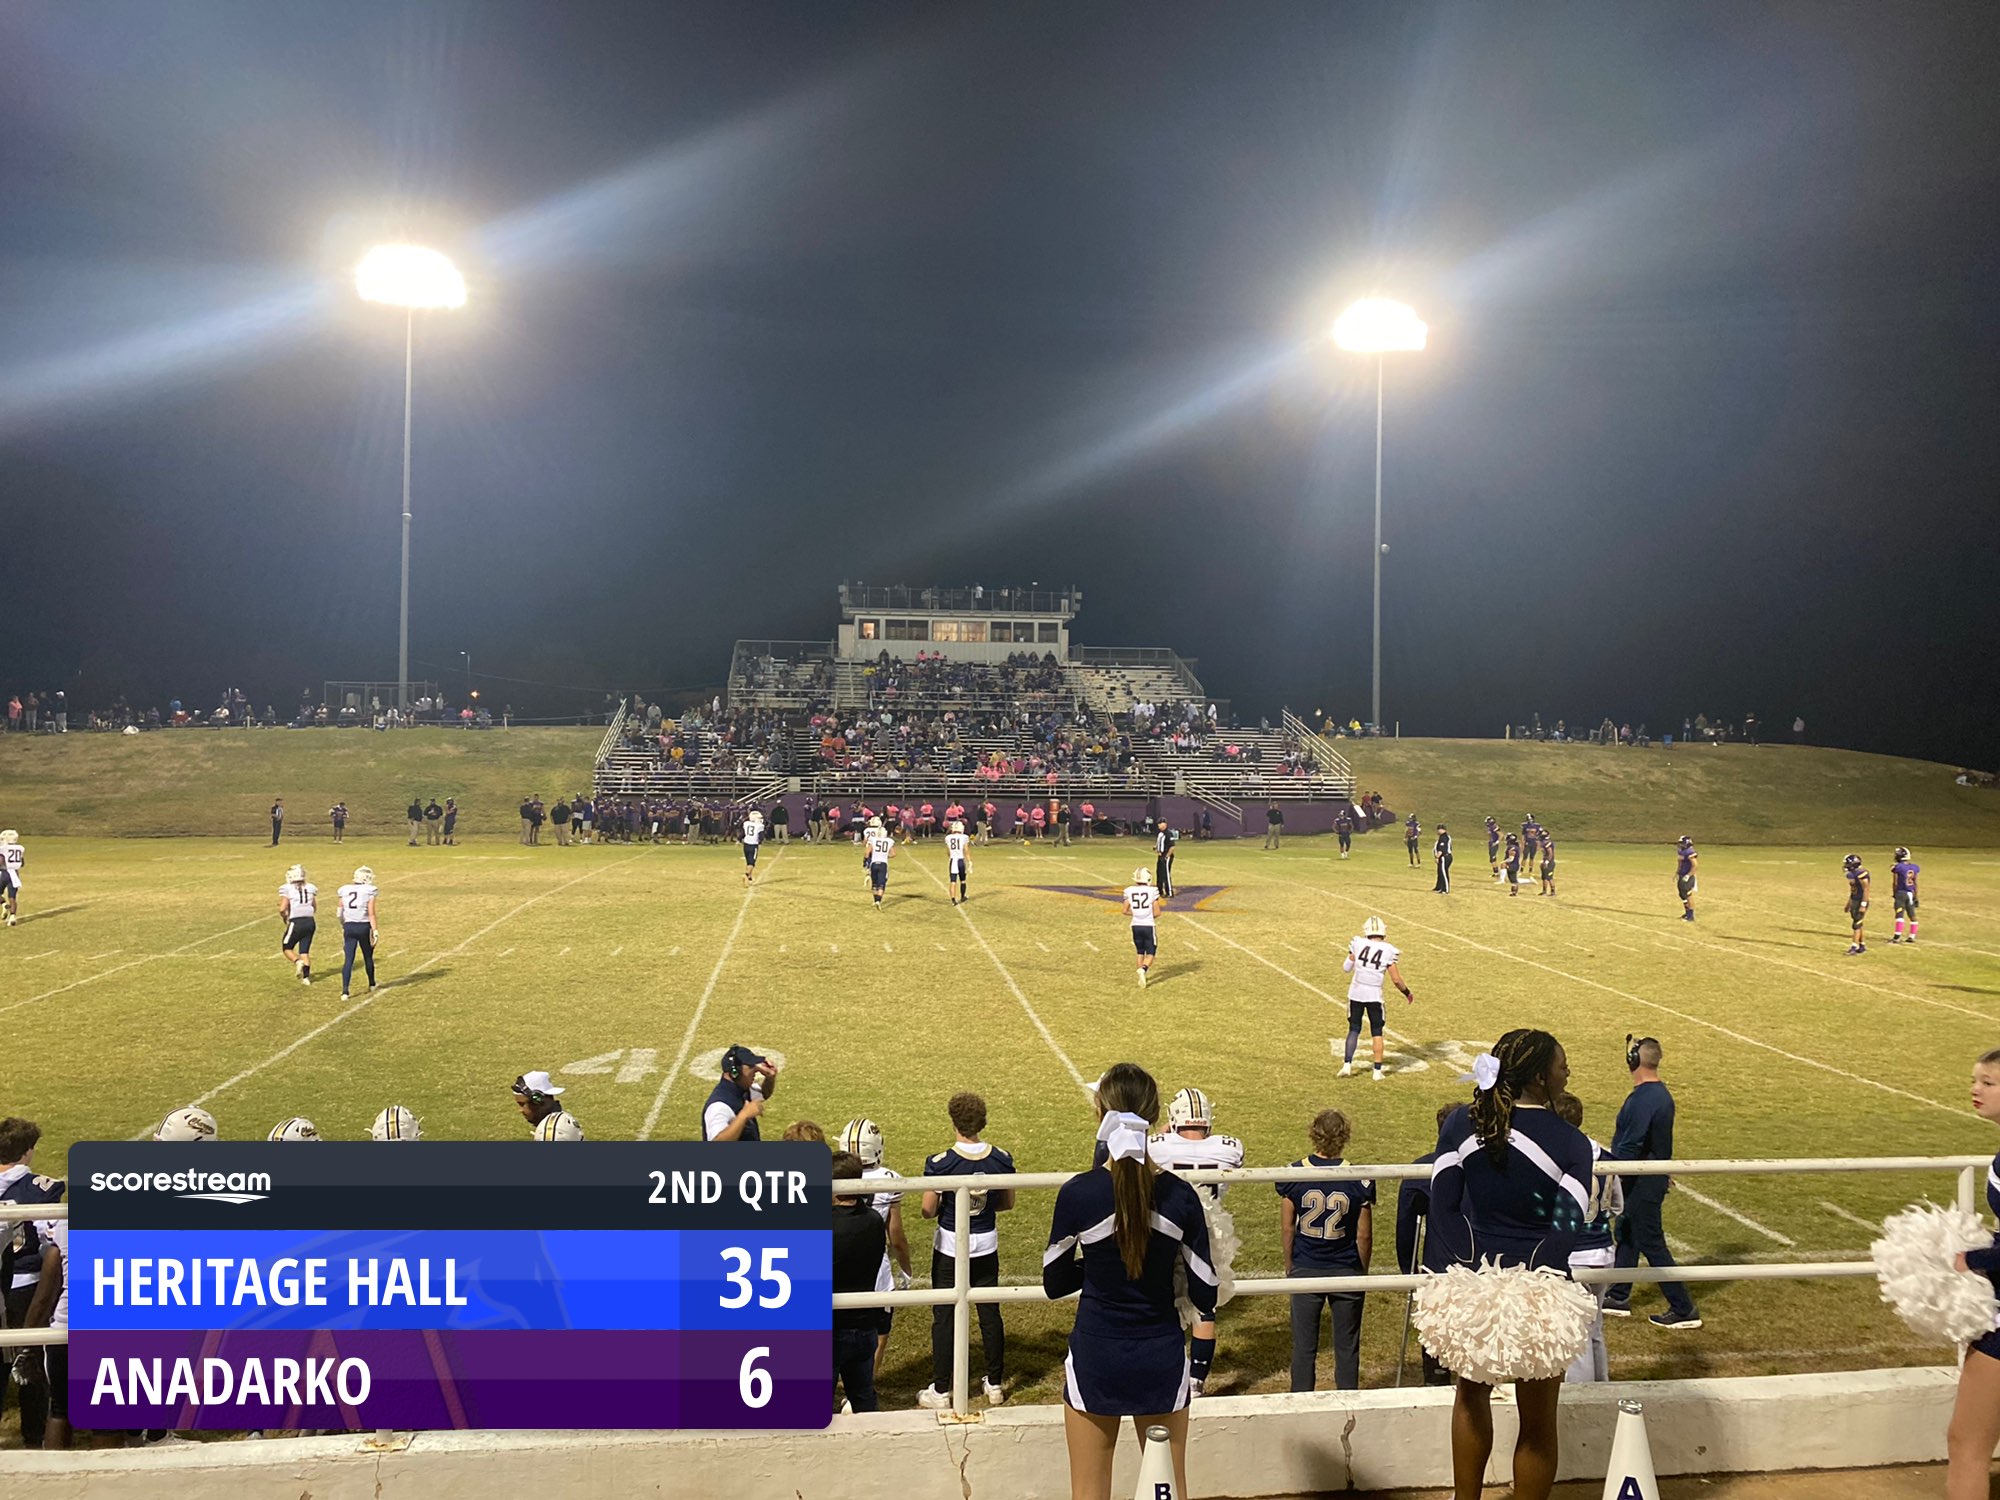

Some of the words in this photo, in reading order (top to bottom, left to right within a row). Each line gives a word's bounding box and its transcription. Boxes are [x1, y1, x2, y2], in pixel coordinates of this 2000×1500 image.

[875, 840, 889, 853] 50
[950, 838, 961, 850] 81
[8, 849, 22, 863] 20
[348, 891, 358, 909] 2
[1131, 892, 1150, 909] 52
[1358, 945, 1384, 970] 44
[1300, 1188, 1350, 1240] 22
